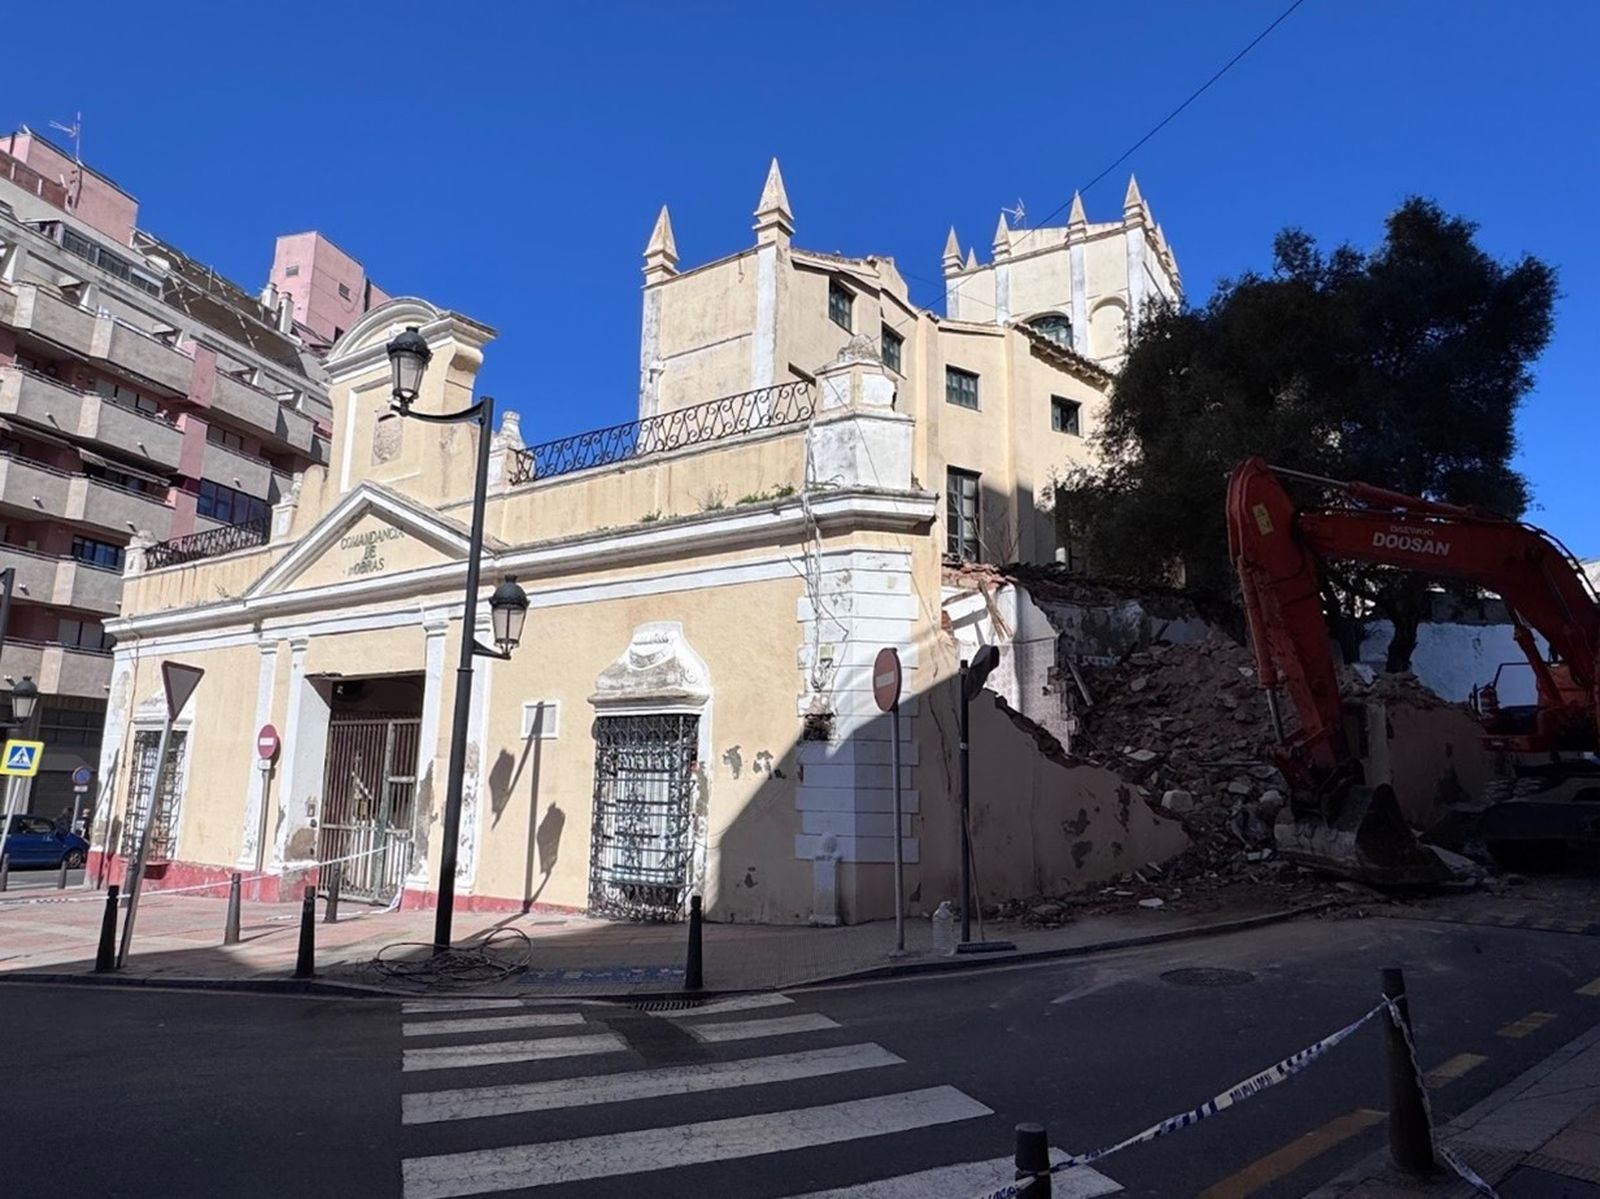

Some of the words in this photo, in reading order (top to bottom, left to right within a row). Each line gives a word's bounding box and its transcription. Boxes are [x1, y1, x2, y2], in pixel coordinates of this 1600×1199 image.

[341, 528, 404, 550] COMANDANCIA
[1372, 532, 1449, 556] DOOSAN
[364, 545, 376, 559] DE
